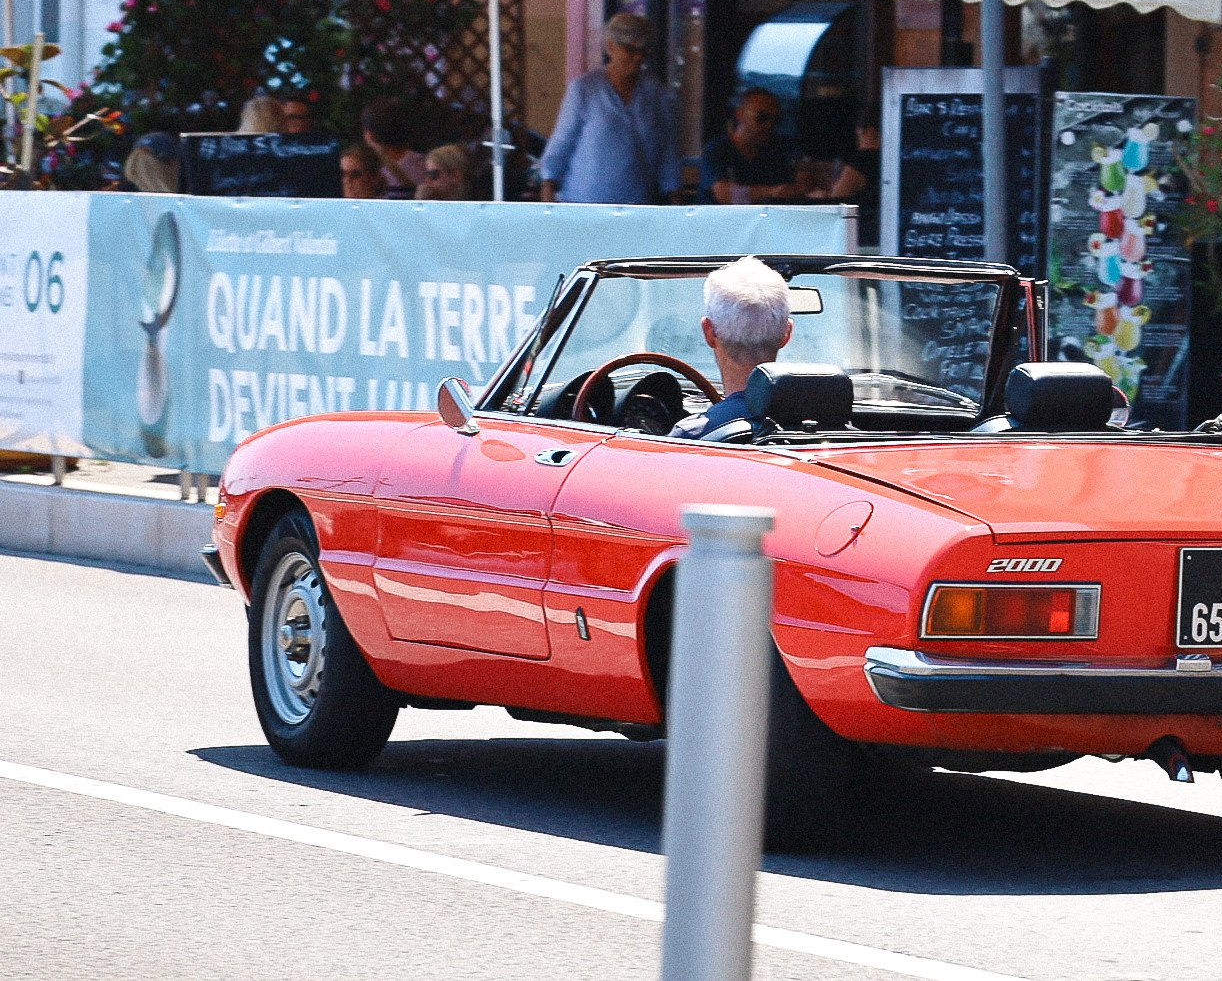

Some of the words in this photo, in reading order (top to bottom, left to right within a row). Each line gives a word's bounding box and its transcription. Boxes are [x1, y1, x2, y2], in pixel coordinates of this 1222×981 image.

[24, 249, 65, 315] 06
[206, 271, 348, 355] QUAND
[358, 277, 409, 359] LA
[417, 280, 537, 364] TERRE
[986, 557, 1064, 573] 2000
